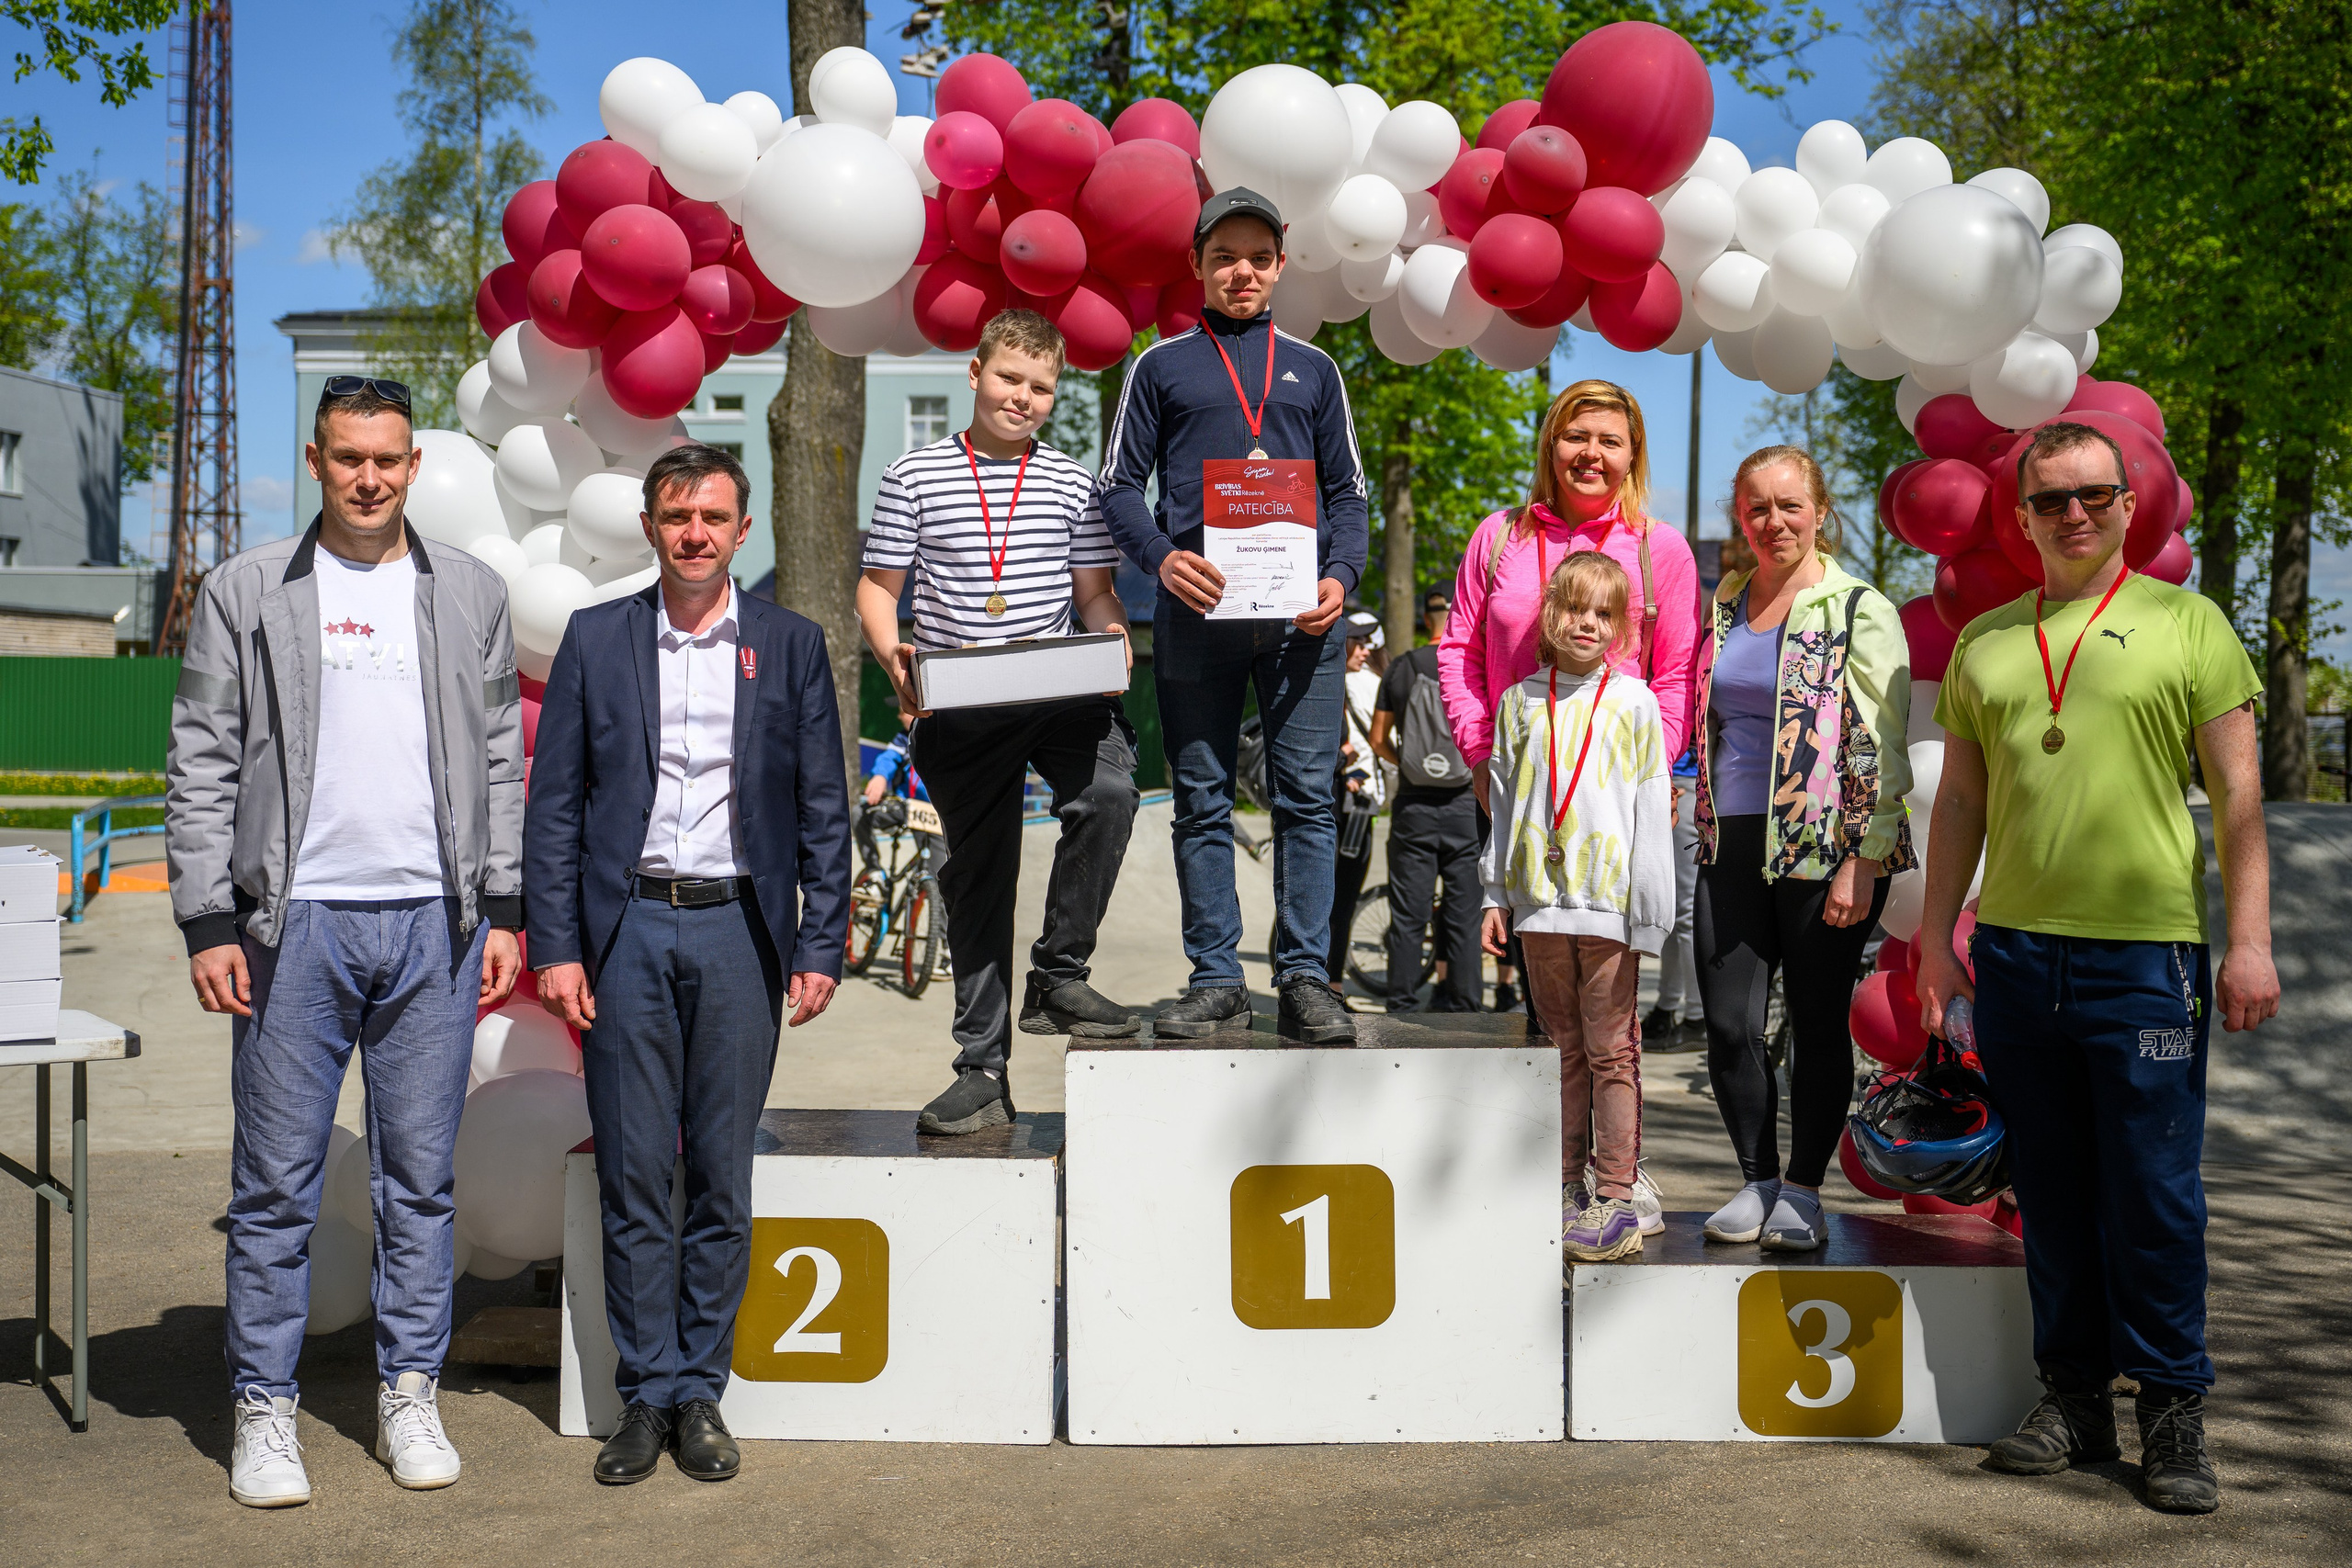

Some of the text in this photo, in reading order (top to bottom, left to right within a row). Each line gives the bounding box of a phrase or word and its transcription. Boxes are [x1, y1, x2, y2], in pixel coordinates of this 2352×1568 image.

[1228, 501, 1294, 515] PATEICĪBA
[912, 809, 937, 826] 165
[773, 1245, 842, 1355] 2
[1279, 1193, 1331, 1300] 1
[1785, 1299, 1856, 1408] 3
